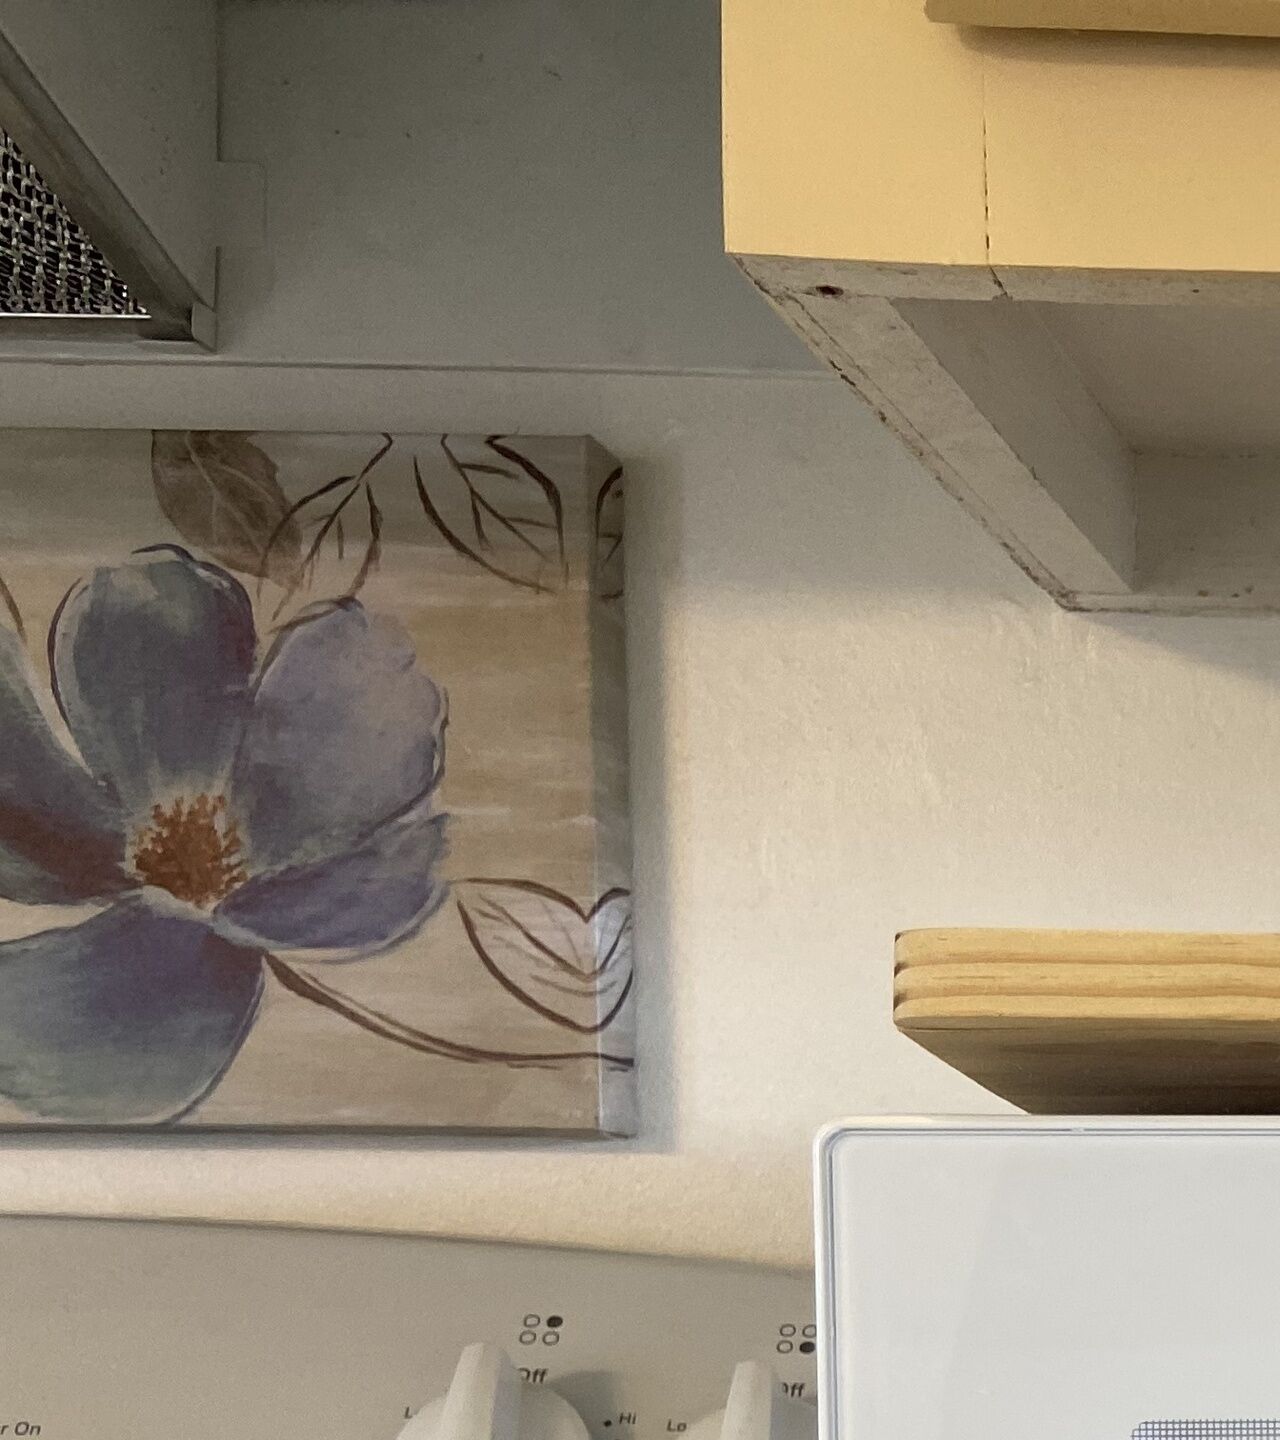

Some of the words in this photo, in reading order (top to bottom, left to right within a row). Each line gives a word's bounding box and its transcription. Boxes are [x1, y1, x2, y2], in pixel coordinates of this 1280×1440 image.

[619, 1412, 637, 1425] Hi
[667, 1418, 687, 1432] Lo
[15, 1421, 41, 1436] On
